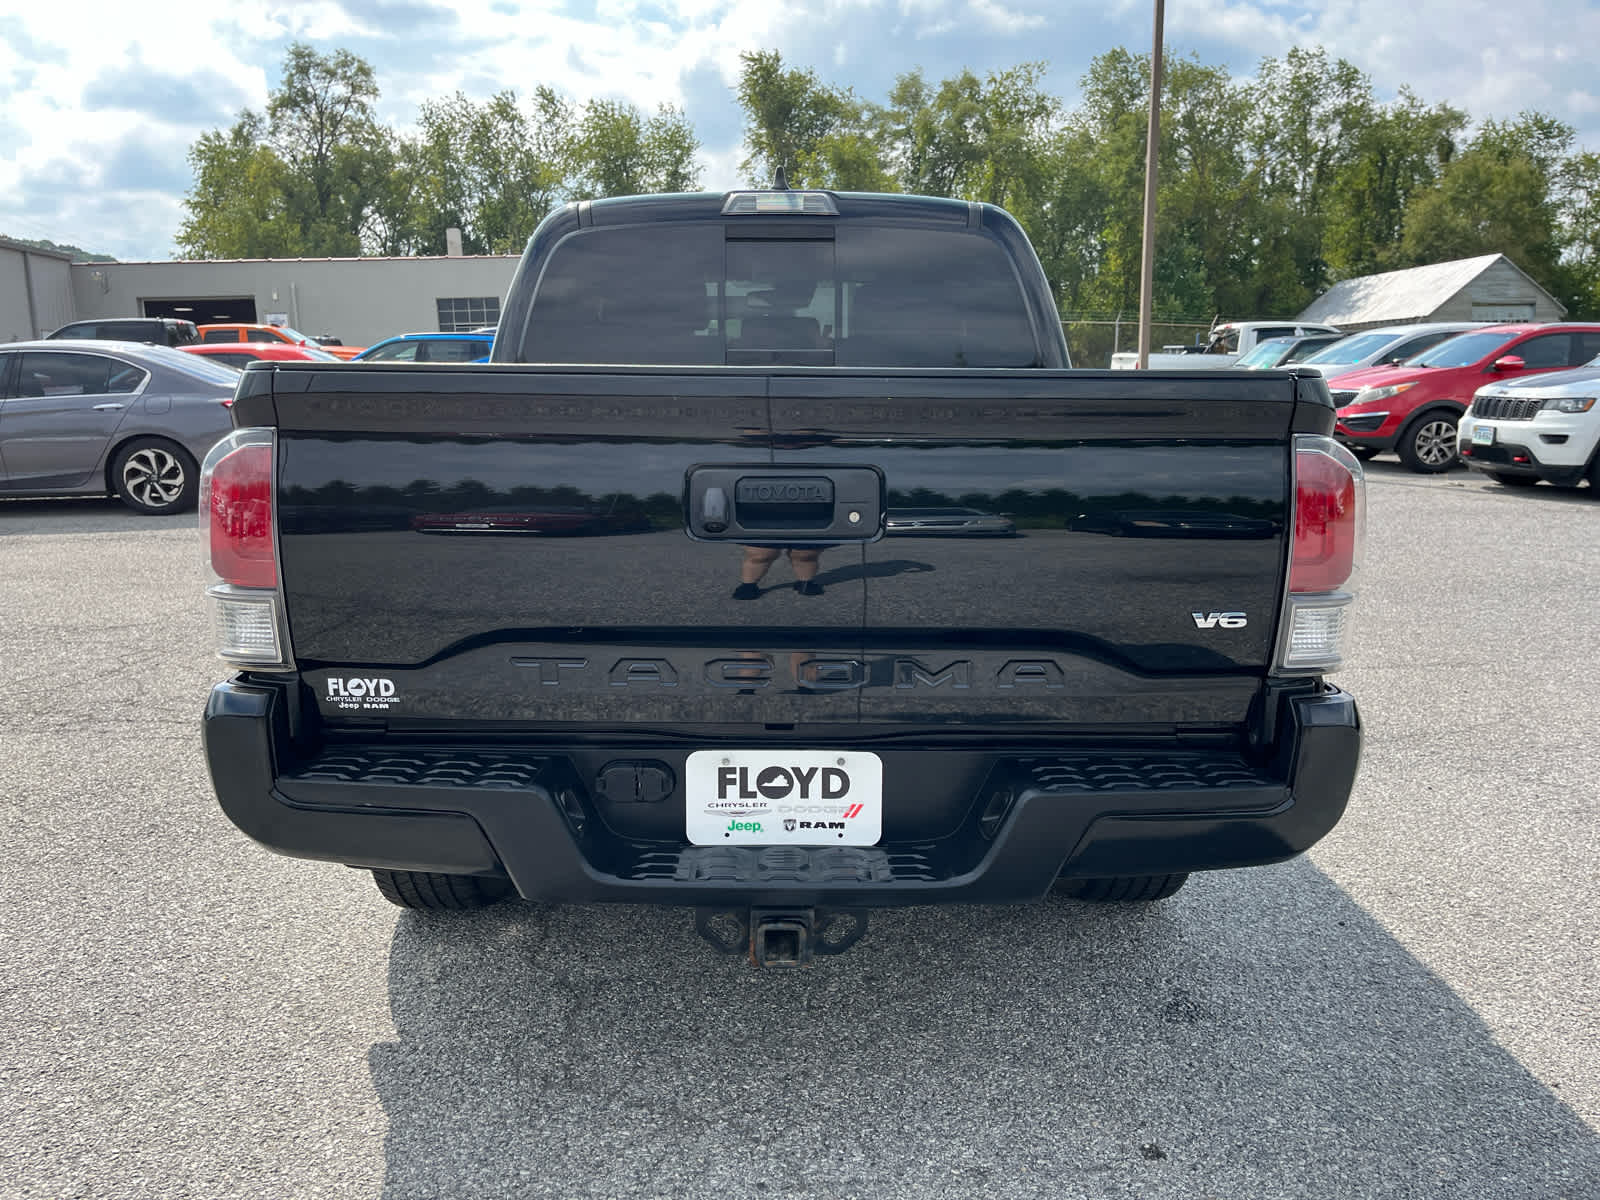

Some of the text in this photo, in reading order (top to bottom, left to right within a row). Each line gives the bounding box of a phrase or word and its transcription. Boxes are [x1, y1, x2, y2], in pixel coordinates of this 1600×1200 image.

[744, 486, 825, 499] TOYOTA
[1191, 612, 1248, 628] V6
[508, 656, 1065, 689] TACOMA
[327, 678, 395, 696] FLOYD
[338, 702, 360, 710] Jeep
[717, 766, 850, 800] FLOYD
[727, 820, 845, 833] Jeep RAM
